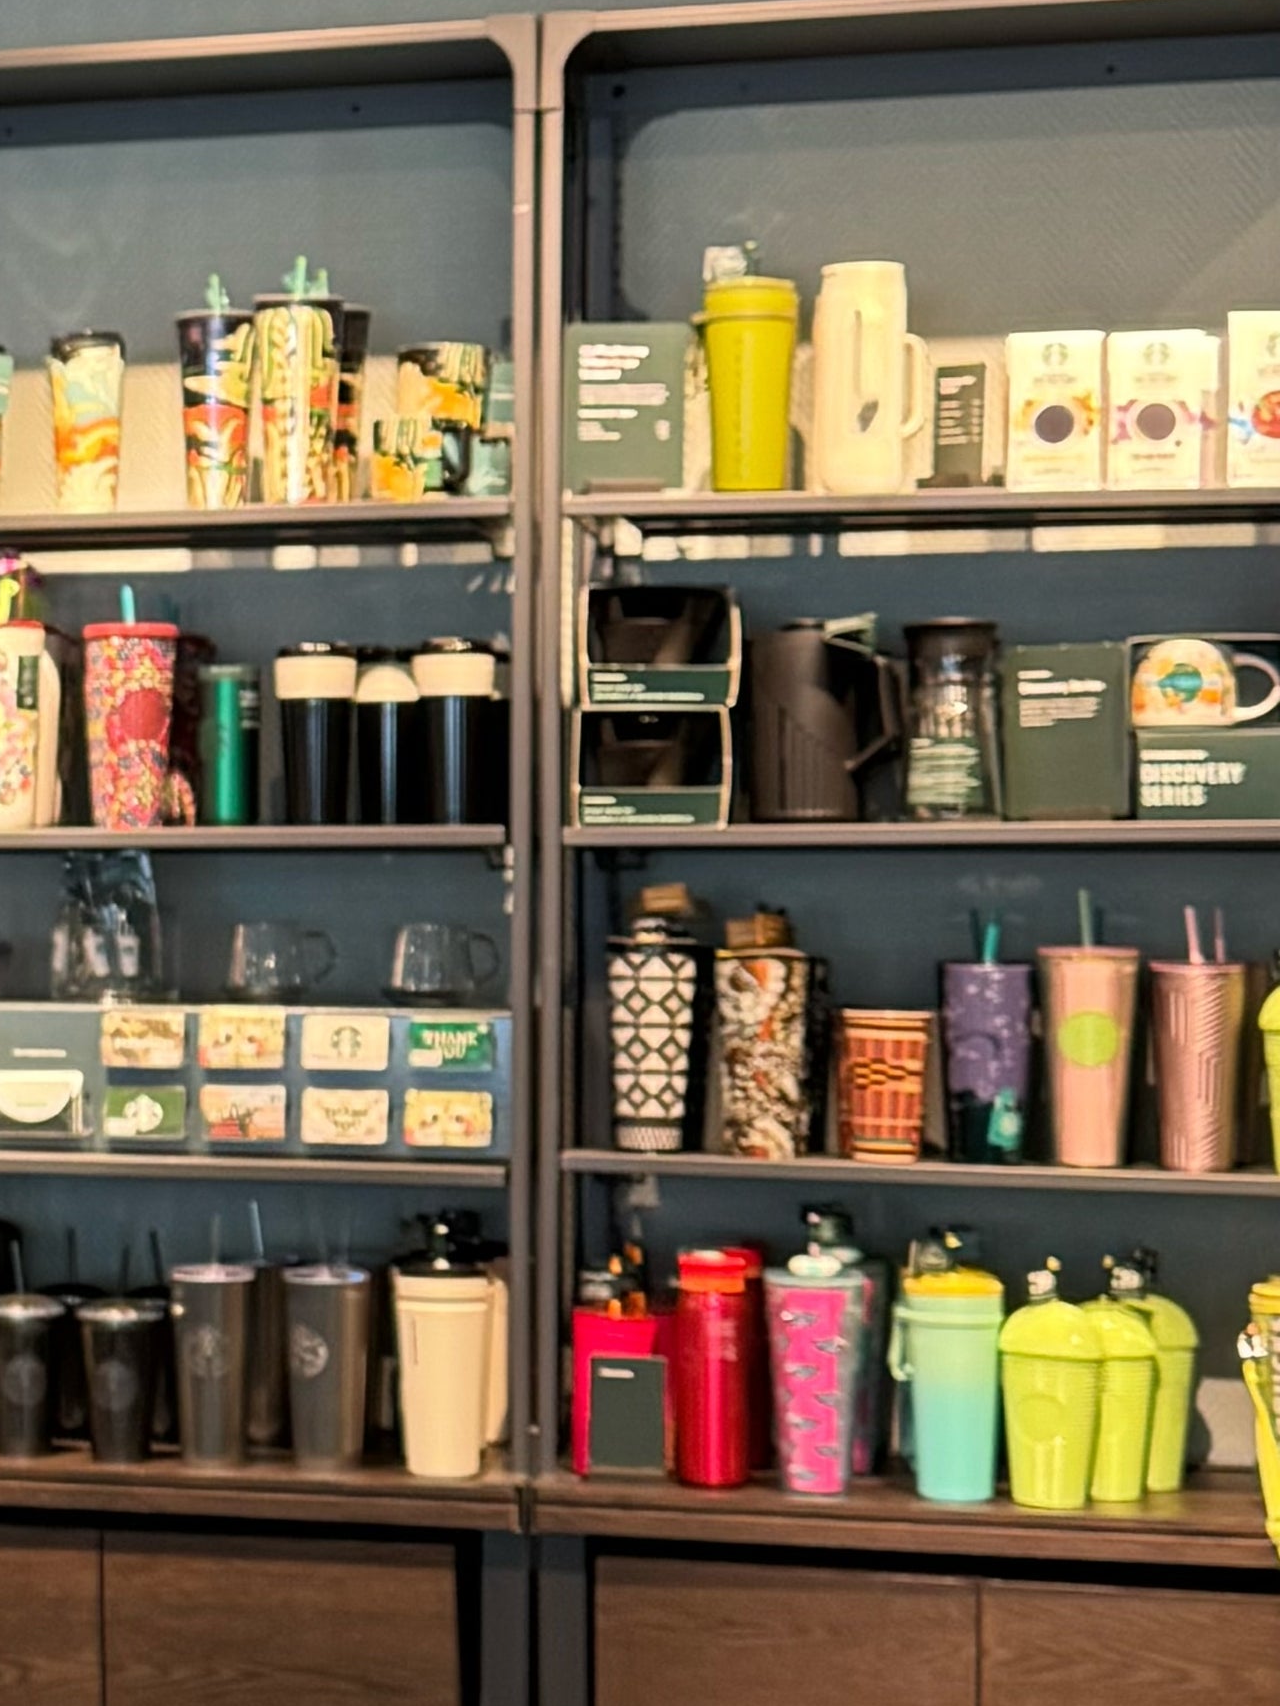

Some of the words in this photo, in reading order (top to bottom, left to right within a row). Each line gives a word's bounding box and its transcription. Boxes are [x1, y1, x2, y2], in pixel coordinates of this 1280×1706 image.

[1140, 762, 1246, 784] DISCOVERY
[1140, 784, 1208, 806] SERIES
[421, 1029, 479, 1046] THANK
